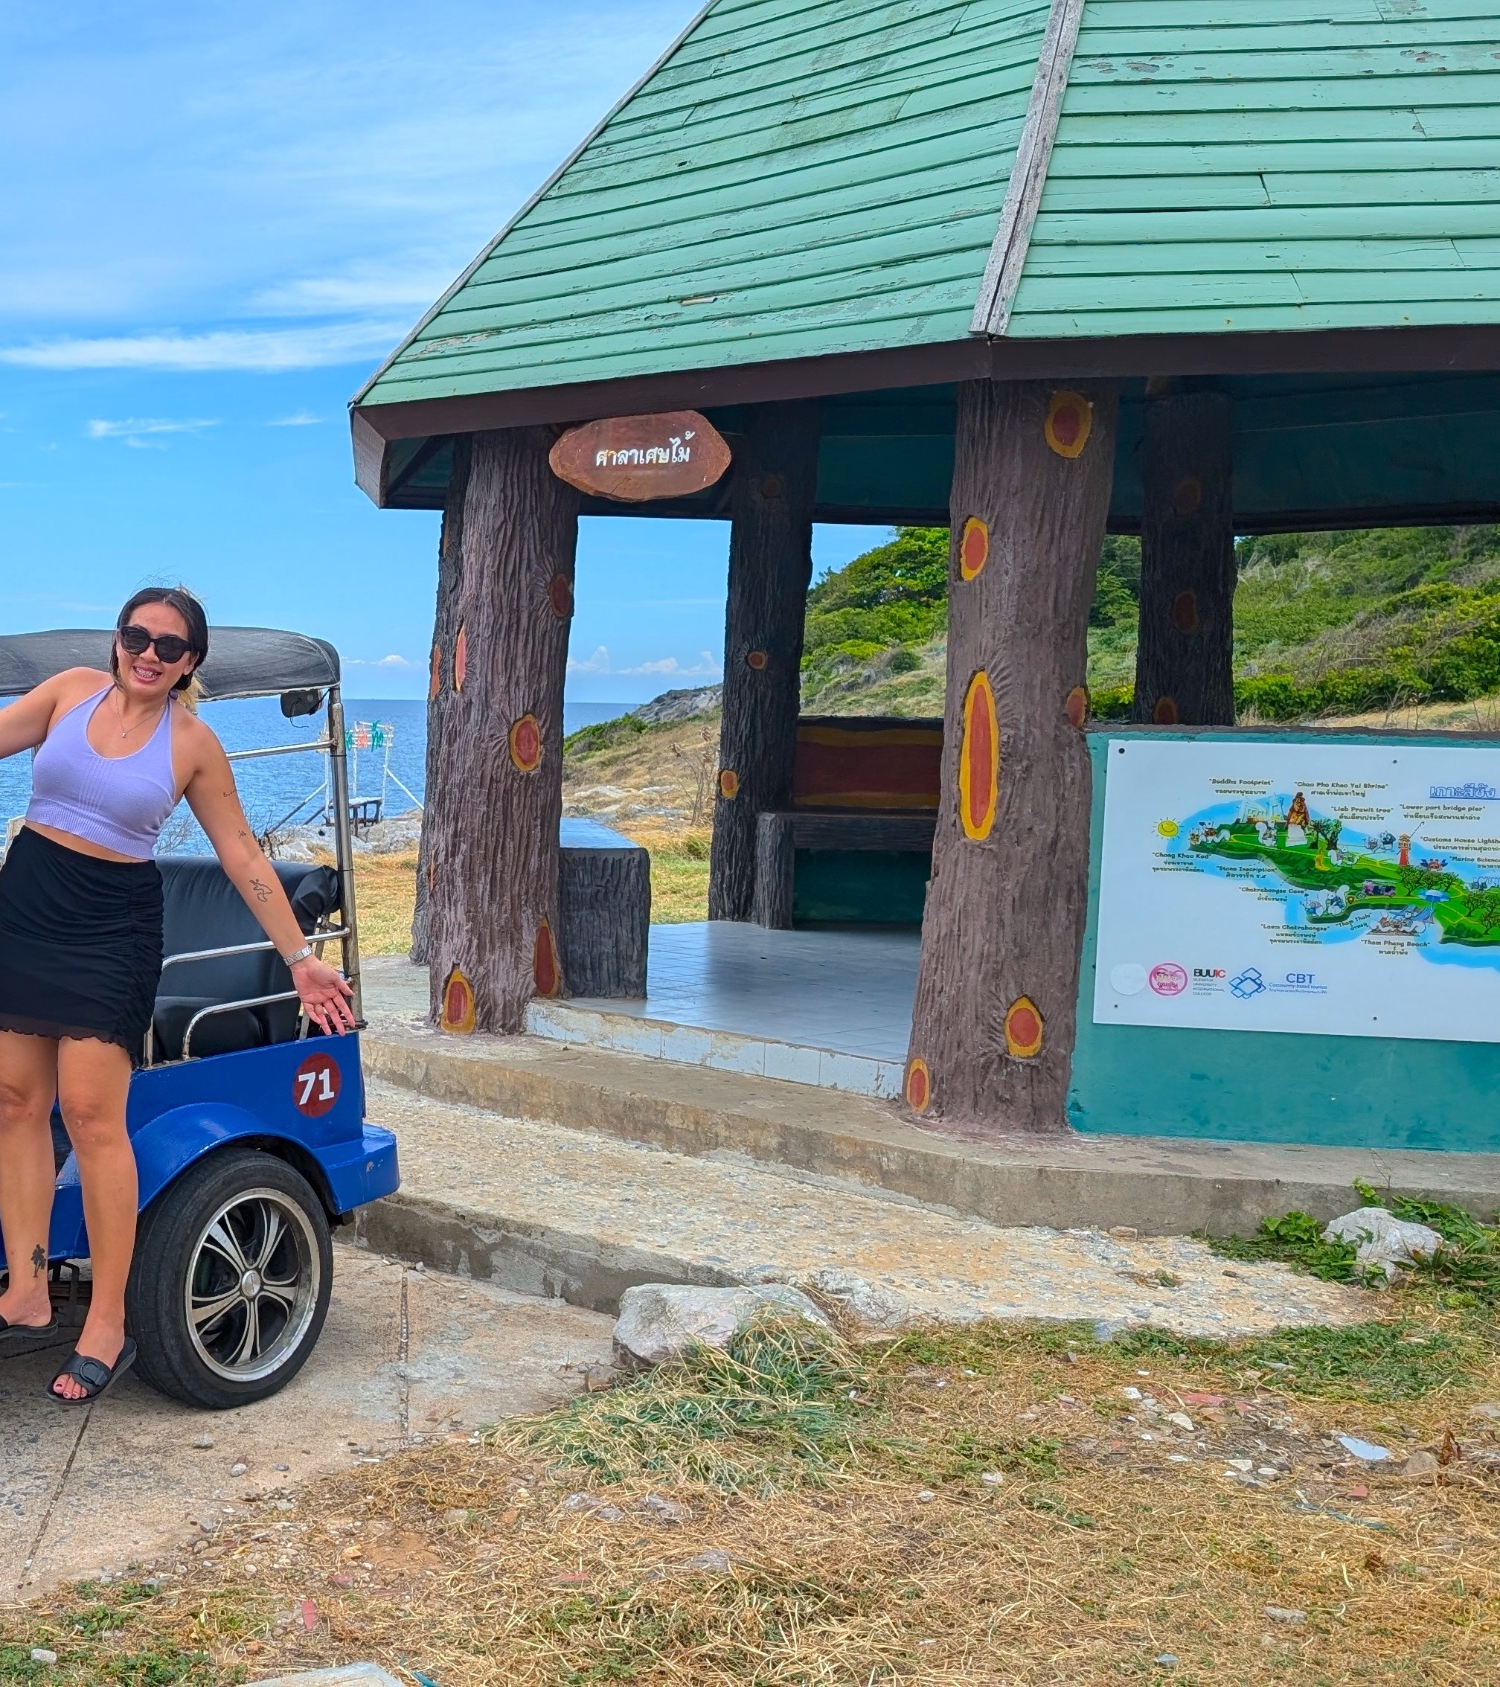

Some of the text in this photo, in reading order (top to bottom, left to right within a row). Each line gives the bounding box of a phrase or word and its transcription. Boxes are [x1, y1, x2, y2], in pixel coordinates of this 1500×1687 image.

[595, 430, 696, 467] ศาลาเศษไม้
[1193, 968, 1227, 978] BUUIC
[1285, 972, 1316, 984] CBT
[298, 1068, 335, 1106] 71
